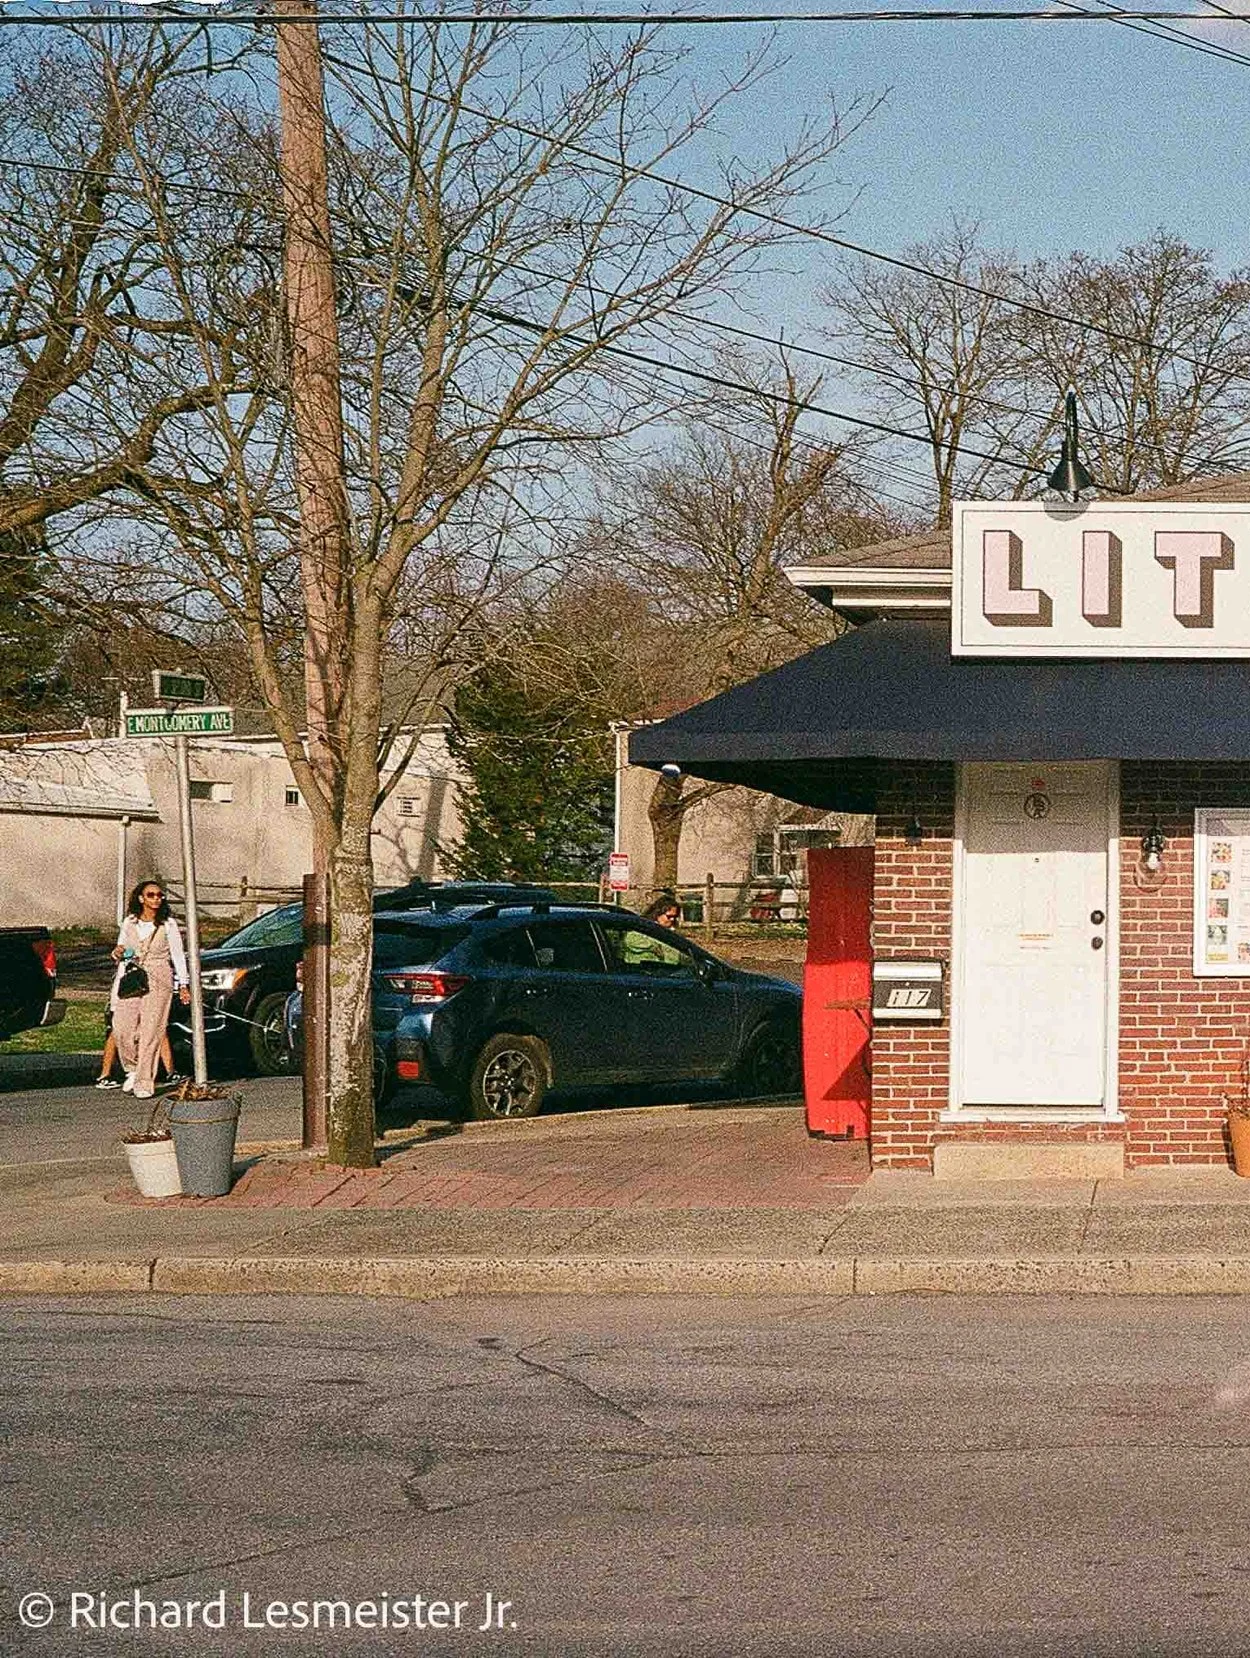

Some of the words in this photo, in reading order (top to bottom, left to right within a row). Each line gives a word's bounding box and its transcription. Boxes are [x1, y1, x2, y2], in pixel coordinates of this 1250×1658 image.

[128, 717, 136, 733] E
[135, 714, 206, 732] MONTGOMERY
[210, 712, 231, 730] AVE
